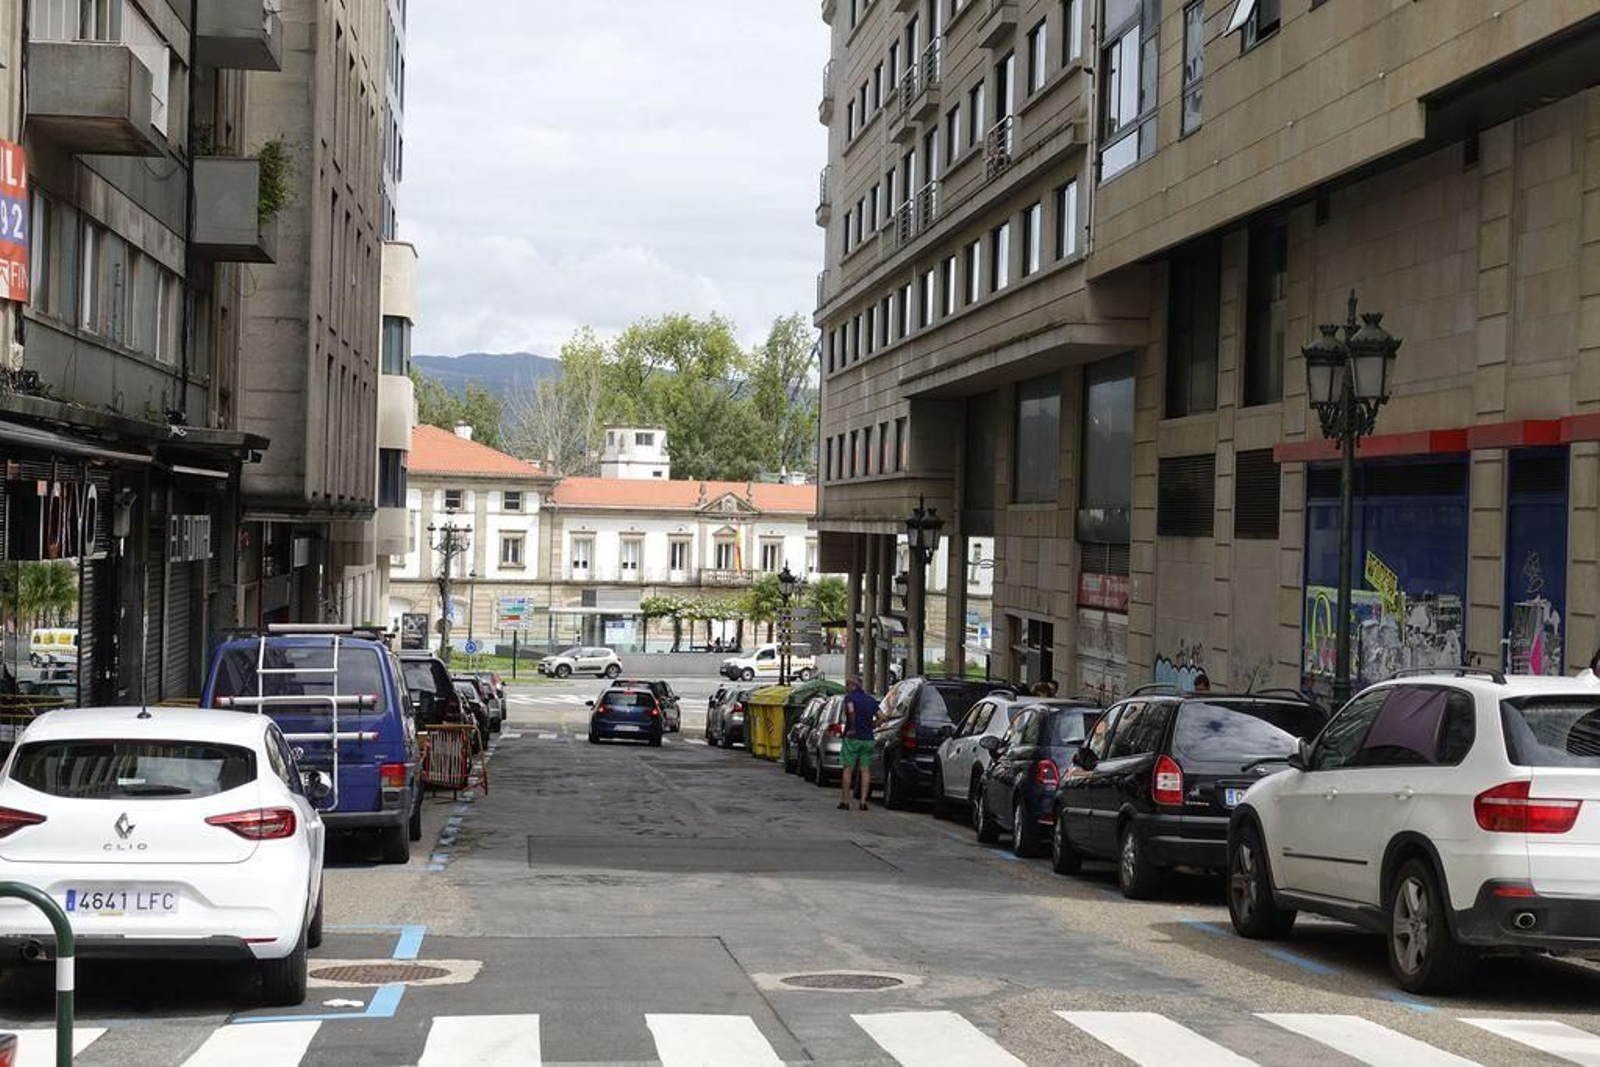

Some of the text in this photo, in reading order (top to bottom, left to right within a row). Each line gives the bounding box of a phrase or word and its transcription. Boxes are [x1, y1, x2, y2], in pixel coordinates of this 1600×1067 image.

[103, 842, 148, 851] CLIO
[79, 892, 174, 910] 4641 LFC
